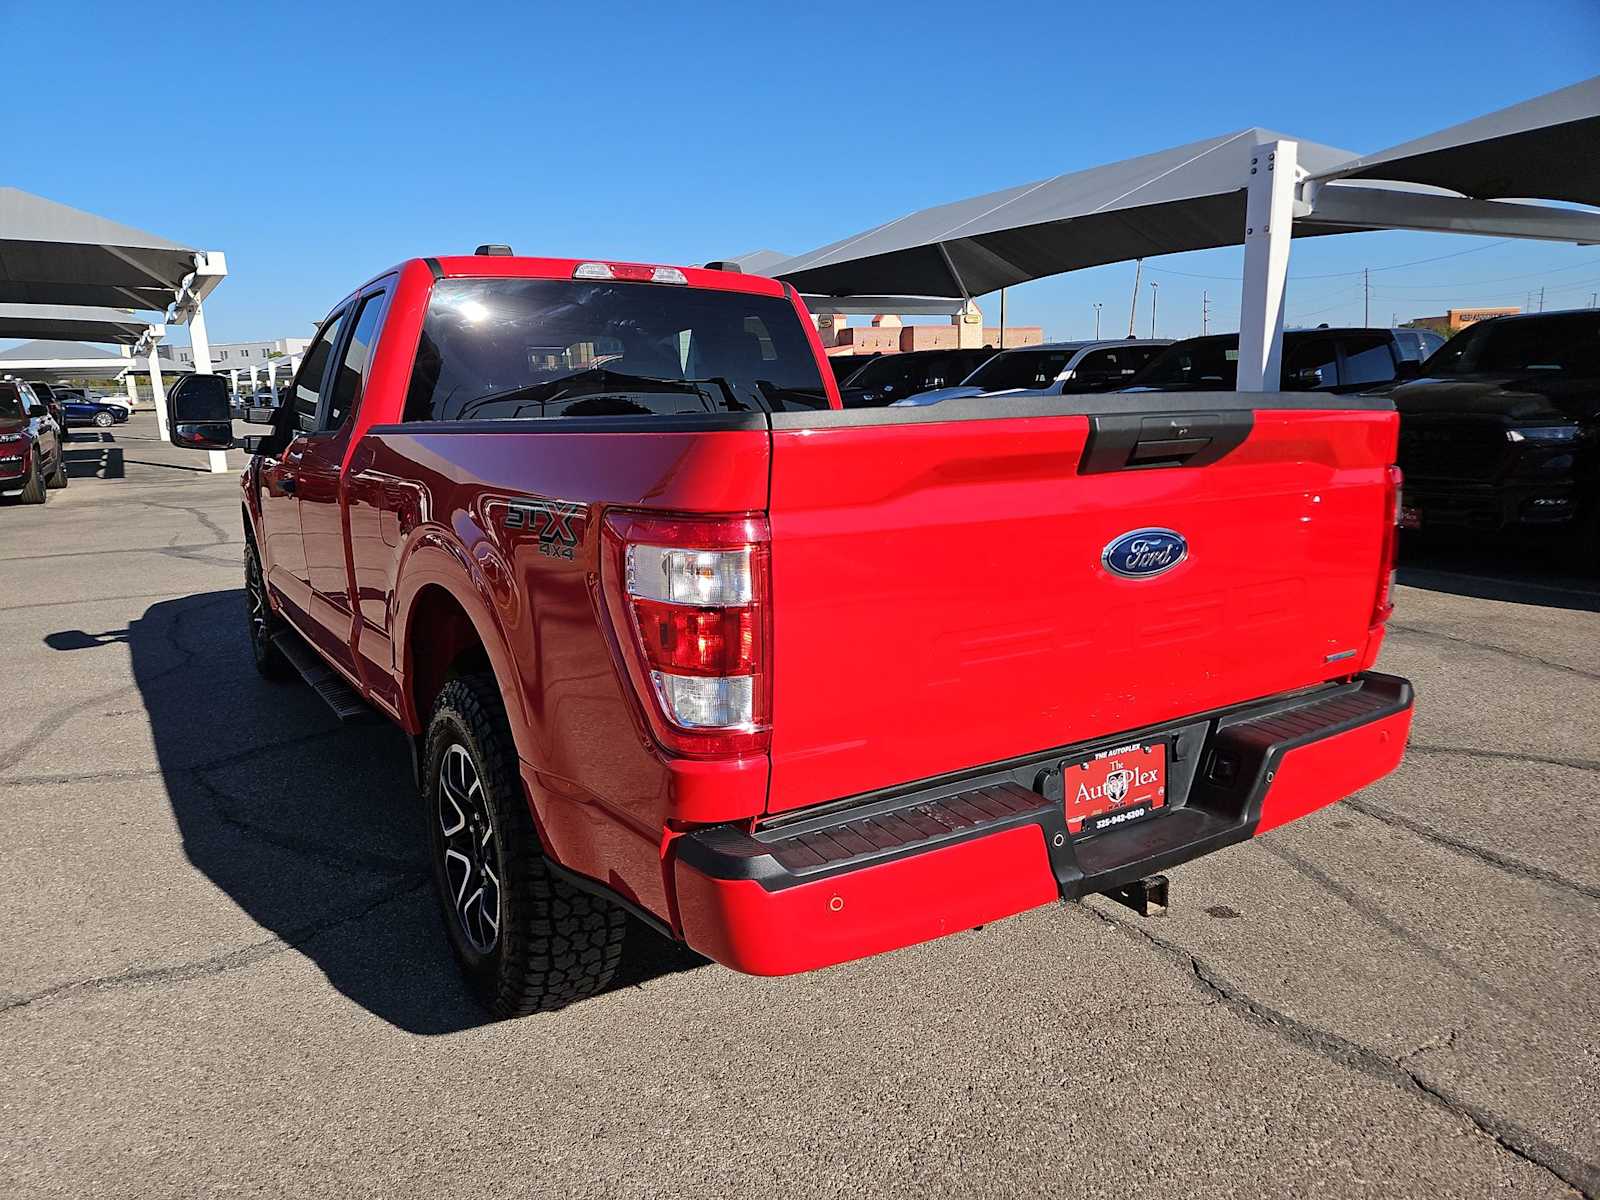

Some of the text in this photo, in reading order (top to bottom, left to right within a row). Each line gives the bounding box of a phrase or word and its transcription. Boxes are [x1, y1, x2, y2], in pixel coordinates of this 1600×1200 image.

[504, 499, 578, 548] STX
[1126, 539, 1174, 569] Ford
[1095, 744, 1141, 760] THE AUTOPLEX
[1109, 760, 1124, 772] The
